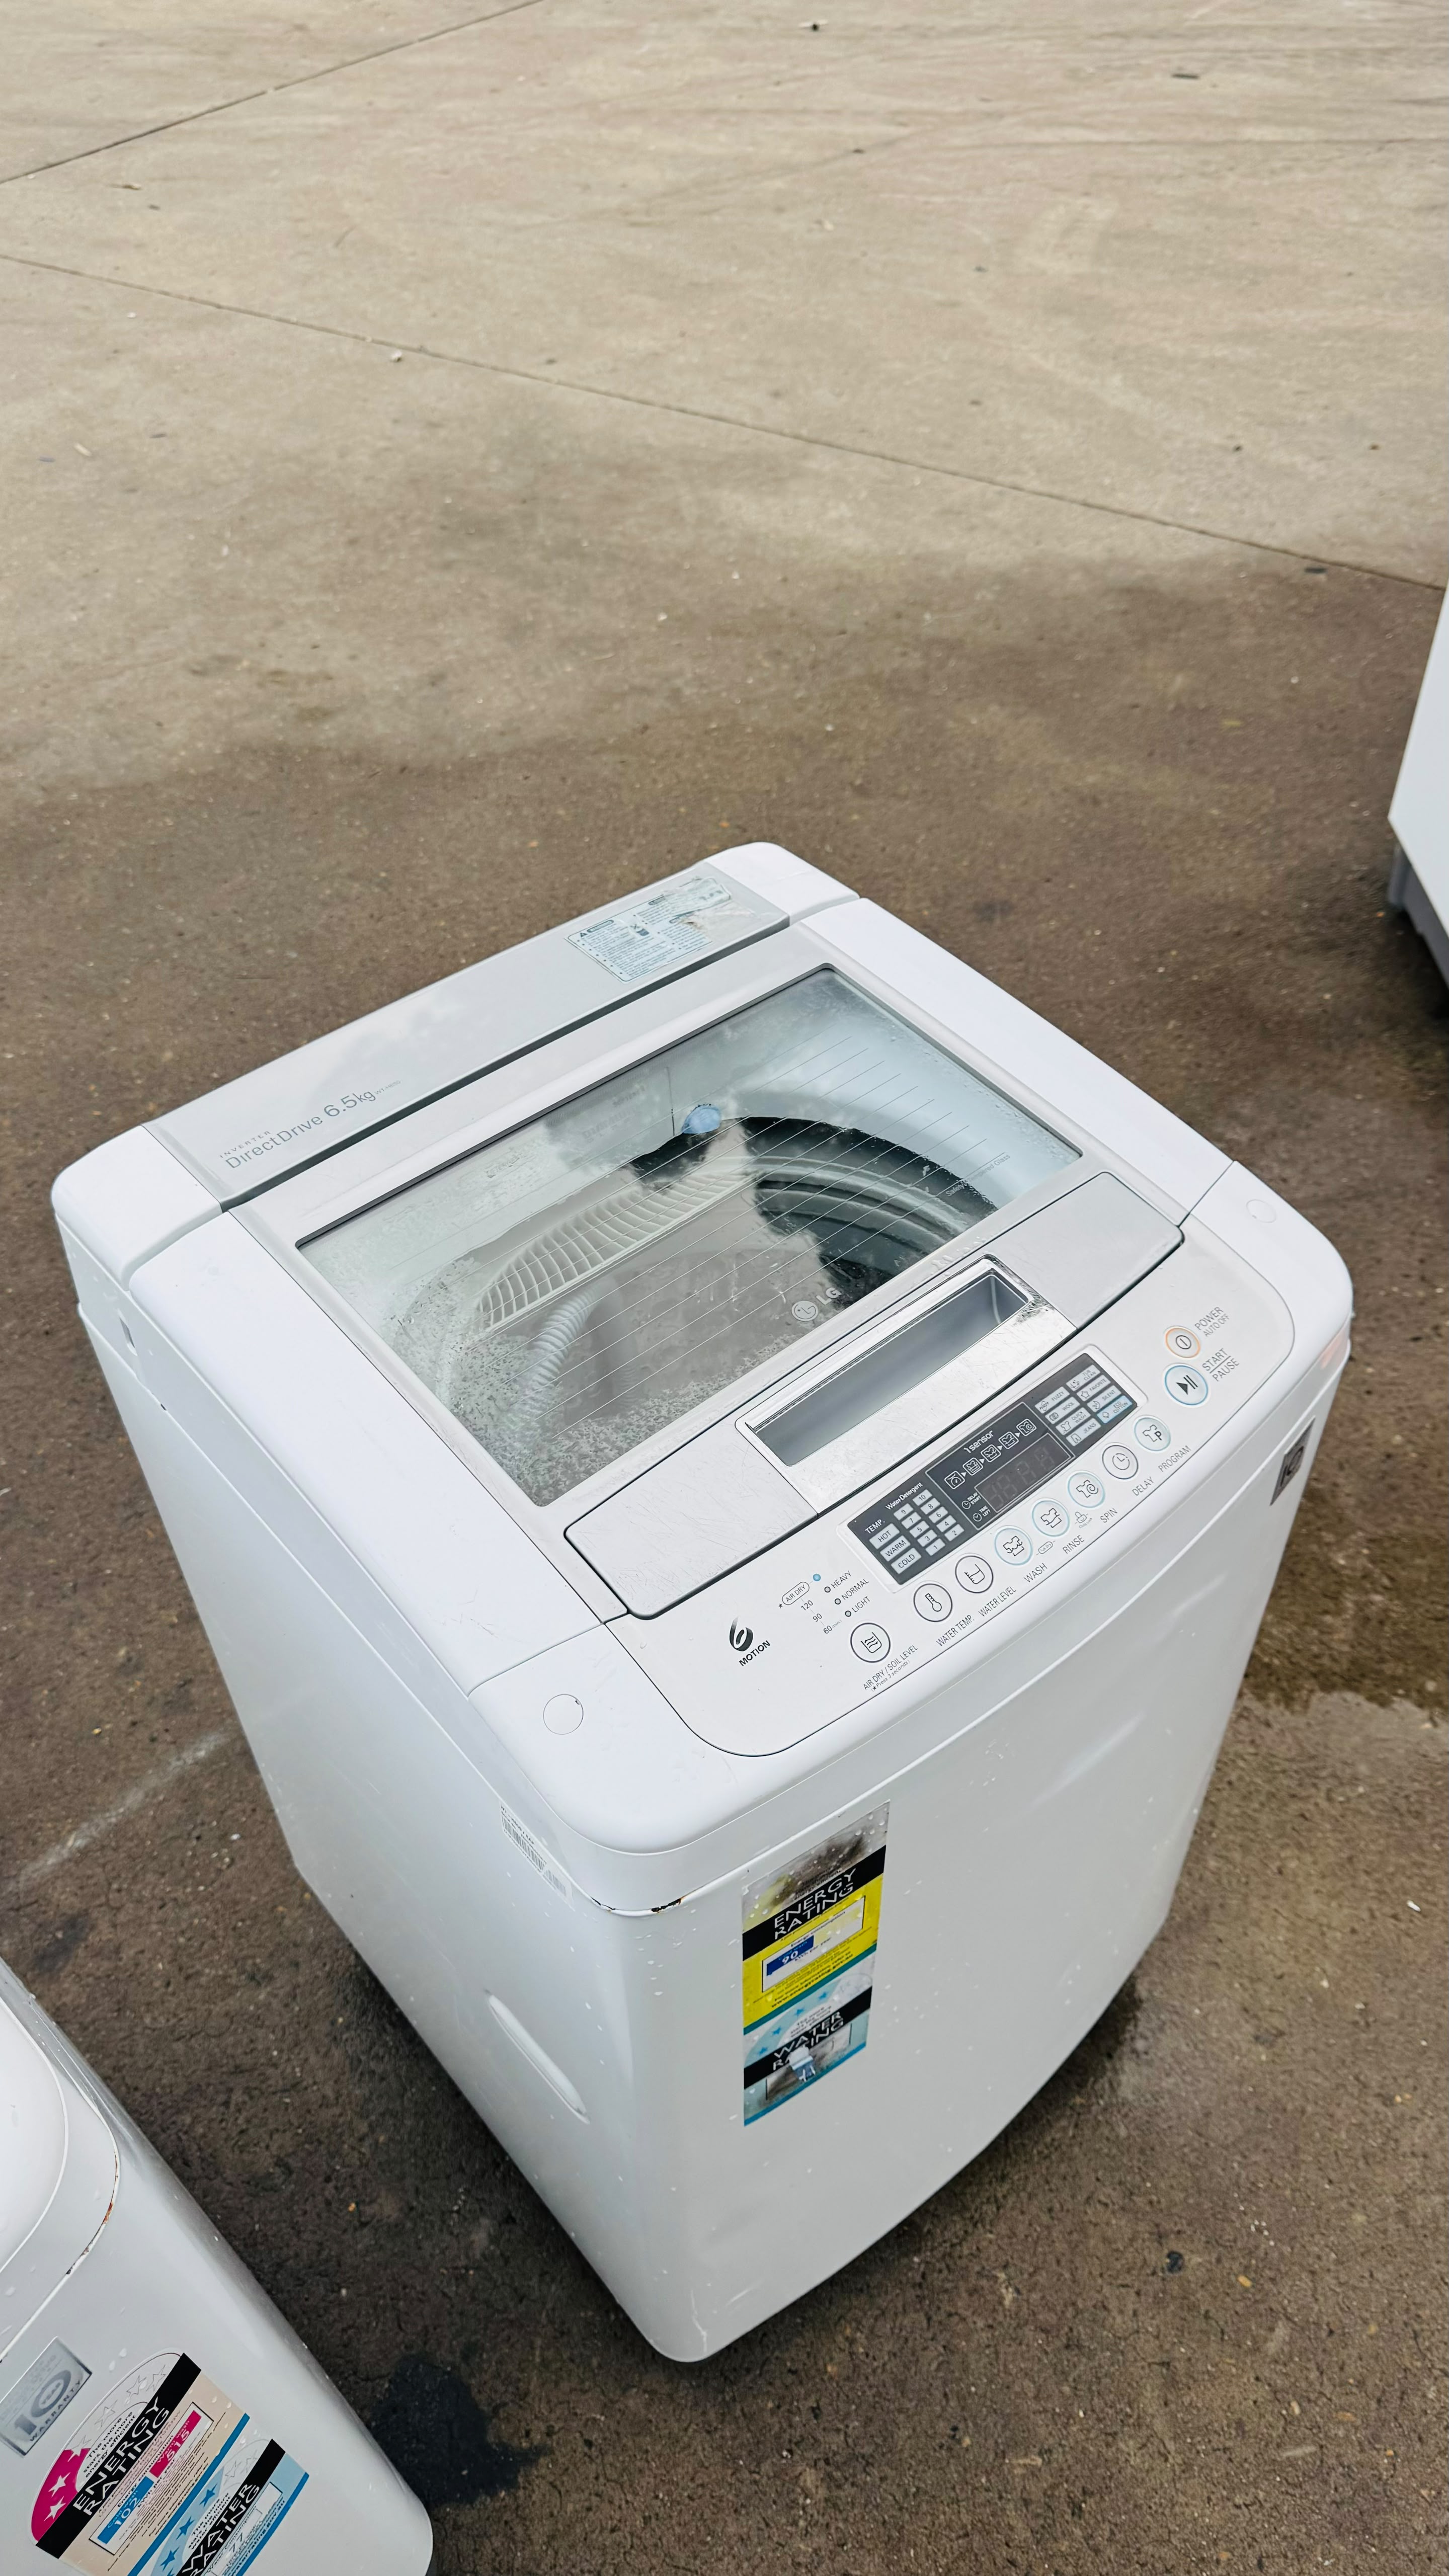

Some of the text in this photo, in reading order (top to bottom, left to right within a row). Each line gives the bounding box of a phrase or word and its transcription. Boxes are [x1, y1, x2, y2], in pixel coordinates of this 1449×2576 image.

[324, 1090, 376, 1117] 6.5kg
[219, 1131, 270, 1158] INVERTER
[993, 1155, 1011, 1166] Glass
[816, 1287, 842, 1306] LG
[1194, 1307, 1224, 1331] POWER
[1203, 1313, 1230, 1337] AUTO OFF
[1202, 1348, 1228, 1372] START
[1212, 1358, 1240, 1382] PAUSE
[1051, 1391, 1065, 1401] FUZZY
[1089, 1378, 1107, 1392] FAVORITE
[1101, 1389, 1116, 1401] SILENT
[1062, 1401, 1075, 1411] WOOL
[1071, 1411, 1083, 1421] QUICK
[1113, 1402, 1129, 1414] COTTON
[1074, 1413, 1087, 1424] WASH
[1083, 1422, 1097, 1434] JEANS
[1158, 1445, 1191, 1472] PROGRAM
[1132, 1476, 1154, 1496] DELAY
[970, 1495, 982, 1505] START
[864, 1518, 886, 1534] TEMP.
[1100, 1507, 1118, 1523] SPIN
[877, 1530, 892, 1543] HOT
[886, 1540, 906, 1557] WARM
[1062, 1535, 1085, 1554] RINSE
[898, 1554, 915, 1569] COLD
[1023, 1562, 1048, 1583] WASH
[830, 1570, 852, 1589] HEAVY
[841, 1578, 869, 1600] NORMAL
[785, 1584, 806, 1602] AIR DRY
[851, 1595, 870, 1613] LIGHT
[978, 1585, 1016, 1617] WATER LEVEL
[800, 1600, 814, 1611] 120
[813, 1613, 823, 1622] 90
[823, 1625, 832, 1634] 60
[936, 1615, 975, 1647] WATER TEMP.
[739, 1640, 771, 1666] MOTION
[863, 1679, 874, 1691] AIR
[872, 1669, 885, 1683] DRY
[887, 1658, 902, 1671] SOIL
[900, 1644, 918, 1660] LEVEL
[774, 1868, 856, 1928] ENERGY
[775, 1882, 854, 1940] RATING
[781, 1950, 799, 1965] 90
[773, 2017, 844, 2071] RING
[774, 2011, 841, 2058] WATER
[29, 2379, 81, 2442] WARRANTY
[83, 2411, 133, 2473] stars the more
[86, 2418, 122, 2459] The more
[86, 2415, 136, 2478] energy efficient
[166, 2430, 190, 2461] 515
[72, 2395, 159, 2511] ENERGY
[83, 2407, 170, 2516] RATING
[117, 2483, 137, 2508] Energy
[138, 2435, 174, 2481] consumption
[137, 2459, 175, 2508] kWh per year
[114, 2497, 140, 2526] 102
[188, 2492, 229, 2549] stars the more
[192, 2498, 220, 2536] The more
[182, 2484, 253, 2573] WATER
[190, 2484, 260, 2576] RATING
[228, 2532, 244, 2553] 77
